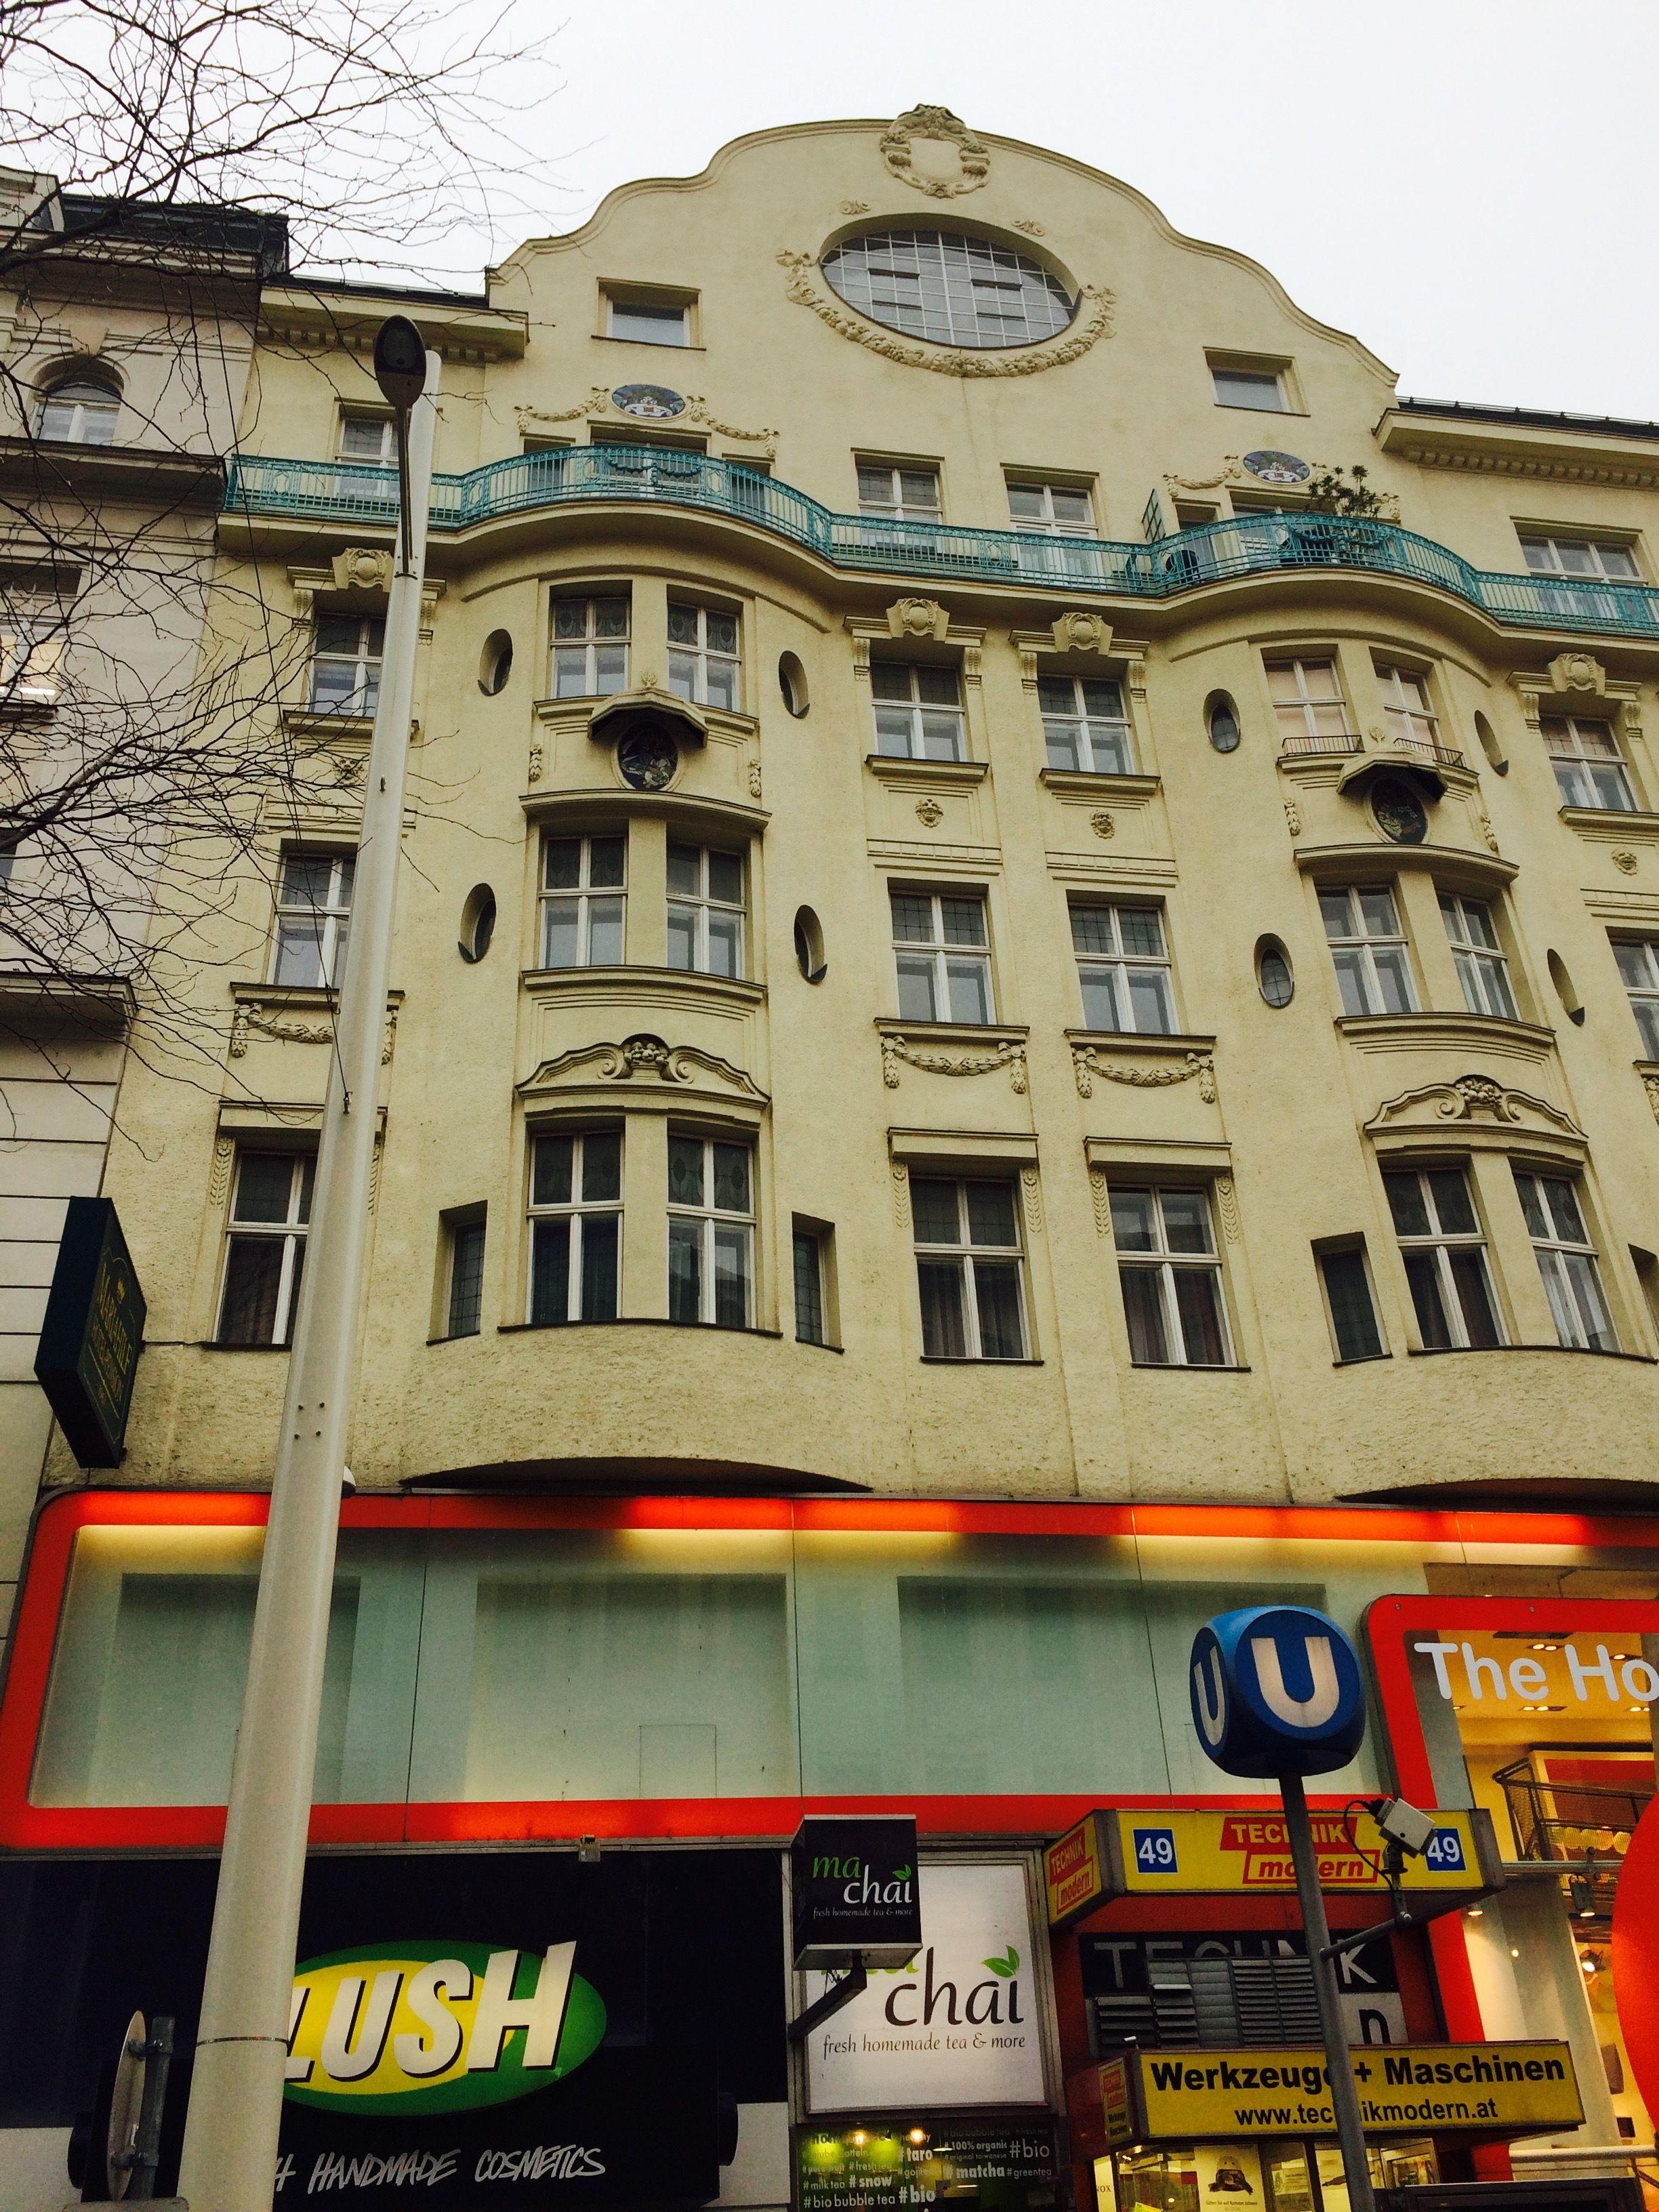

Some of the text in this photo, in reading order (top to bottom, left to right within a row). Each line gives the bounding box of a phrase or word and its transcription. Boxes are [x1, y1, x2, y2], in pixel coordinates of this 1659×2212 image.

[1250, 1636, 1340, 1728] U
[1414, 1642, 1659, 1702] The Ho
[1194, 1645, 1224, 1745] U
[1050, 1836, 1084, 1876] TECHNIK
[1139, 1837, 1174, 1864] 49
[1427, 1837, 1460, 1862] 49
[813, 1857, 861, 1879] ma
[1258, 1856, 1364, 1877] moern
[844, 1864, 912, 1904] chai
[1061, 1871, 1090, 1905] modern
[813, 1906, 830, 1919] fresh
[832, 1906, 870, 1917] homemade
[886, 1907, 894, 1916] &
[884, 1946, 1024, 2026] chai
[823, 2032, 1025, 2060] fresh homemade tea & more
[1384, 2055, 1565, 2085] Maschinen
[1235, 2098, 1498, 2126] www.tecikmodern.at
[977, 2139, 1007, 2152] organic
[308, 2148, 462, 2194] HANDMADE
[474, 2144, 606, 2182] COSMETICS
[834, 2192, 874, 2207] bubble
[877, 2194, 895, 2205] tea
